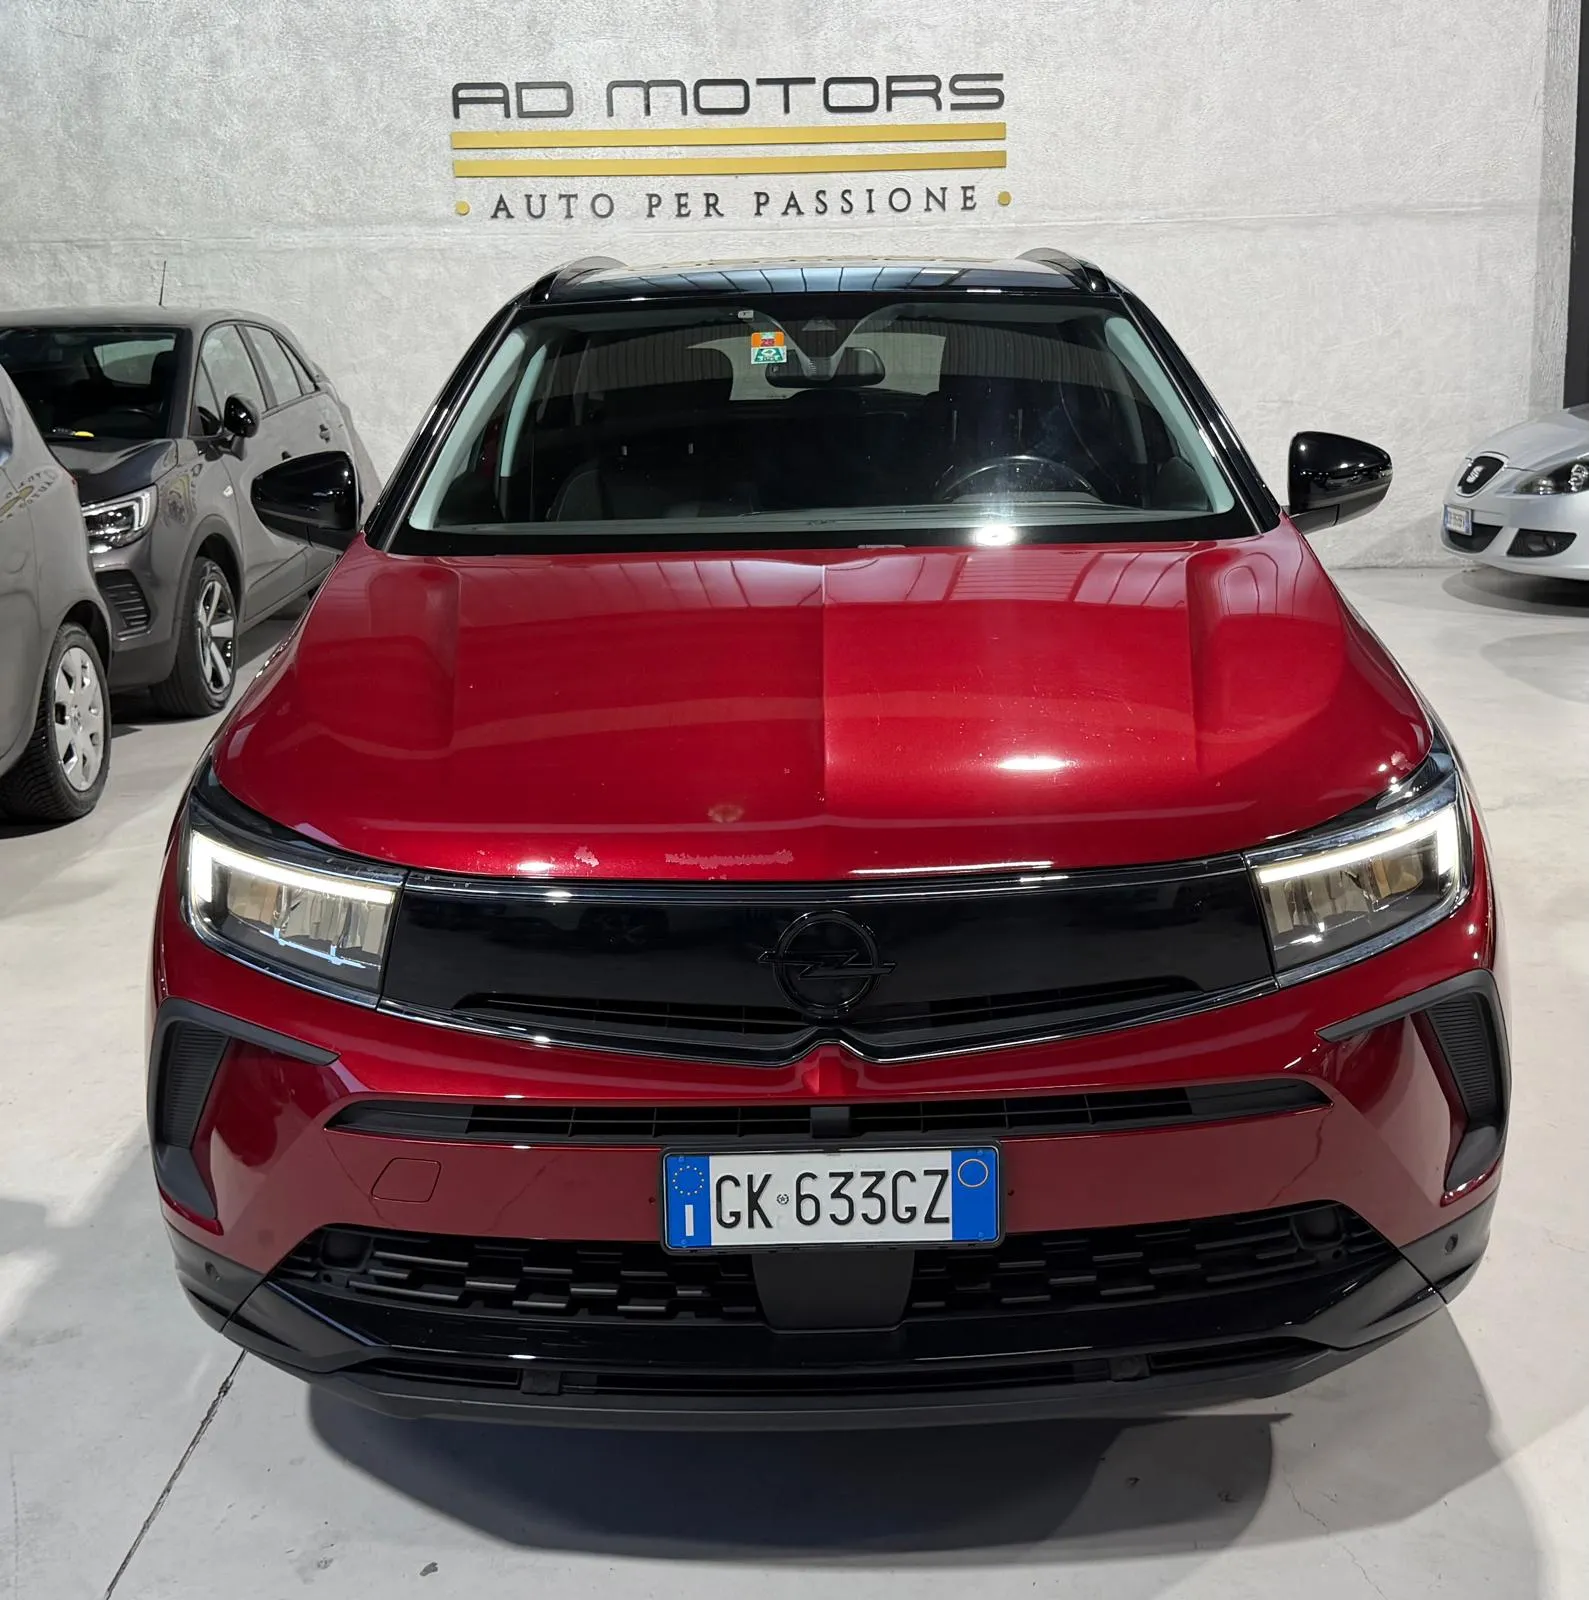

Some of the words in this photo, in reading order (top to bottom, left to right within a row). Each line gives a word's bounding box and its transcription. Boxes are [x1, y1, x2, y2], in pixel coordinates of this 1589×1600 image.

[451, 82, 574, 119] AD
[607, 73, 1005, 117] MOTORS
[490, 193, 615, 219] AUTO
[645, 192, 725, 218] PER
[753, 185, 978, 217] PASSIONE
